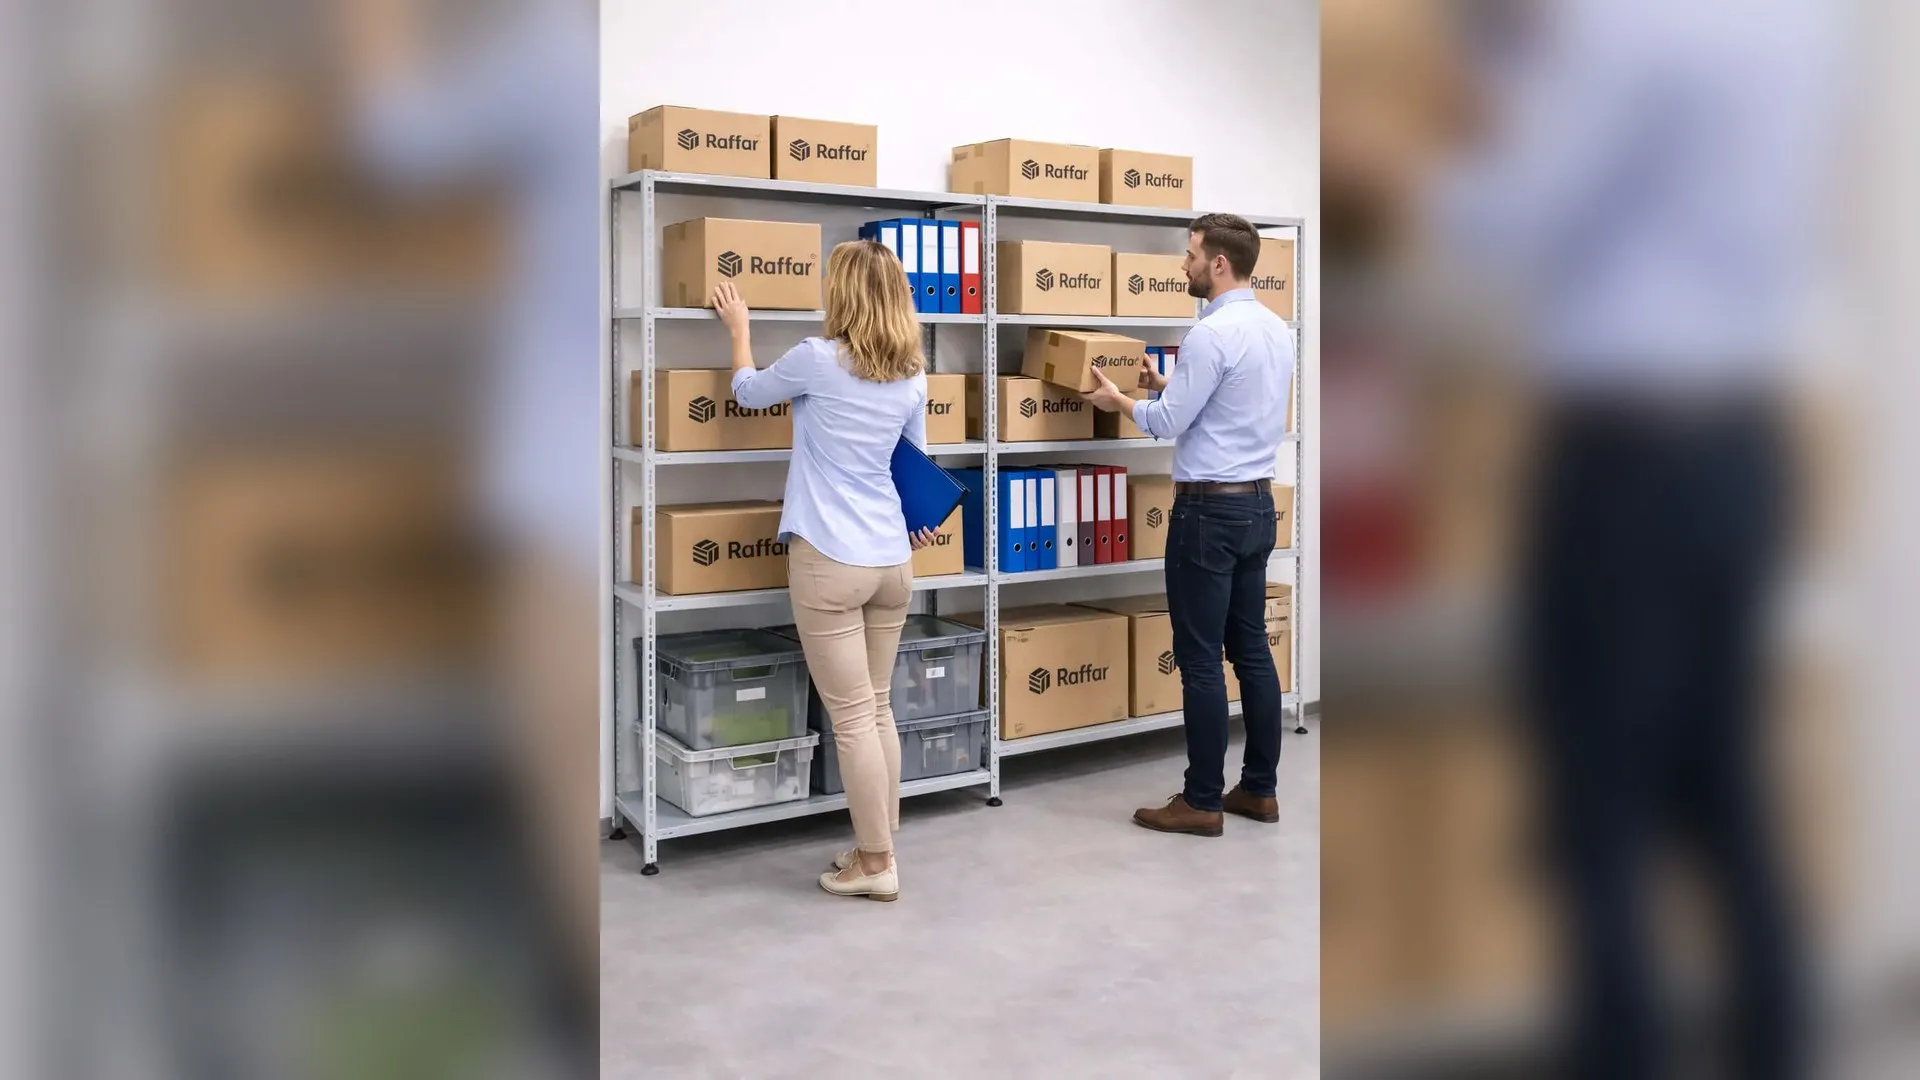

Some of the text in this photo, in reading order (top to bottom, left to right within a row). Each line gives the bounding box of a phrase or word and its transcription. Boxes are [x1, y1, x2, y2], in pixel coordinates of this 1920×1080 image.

[706, 133, 758, 151] Raffar
[816, 143, 867, 162] Raffar
[1045, 163, 1088, 181] Raffar
[1145, 172, 1184, 189] Raffar
[751, 255, 812, 277] Raffar
[1060, 272, 1102, 290] Raffar
[1149, 277, 1187, 292] Raffar
[1250, 275, 1286, 291] Raffar
[1042, 397, 1084, 413] Raffar
[1057, 663, 1109, 687] Raffar
